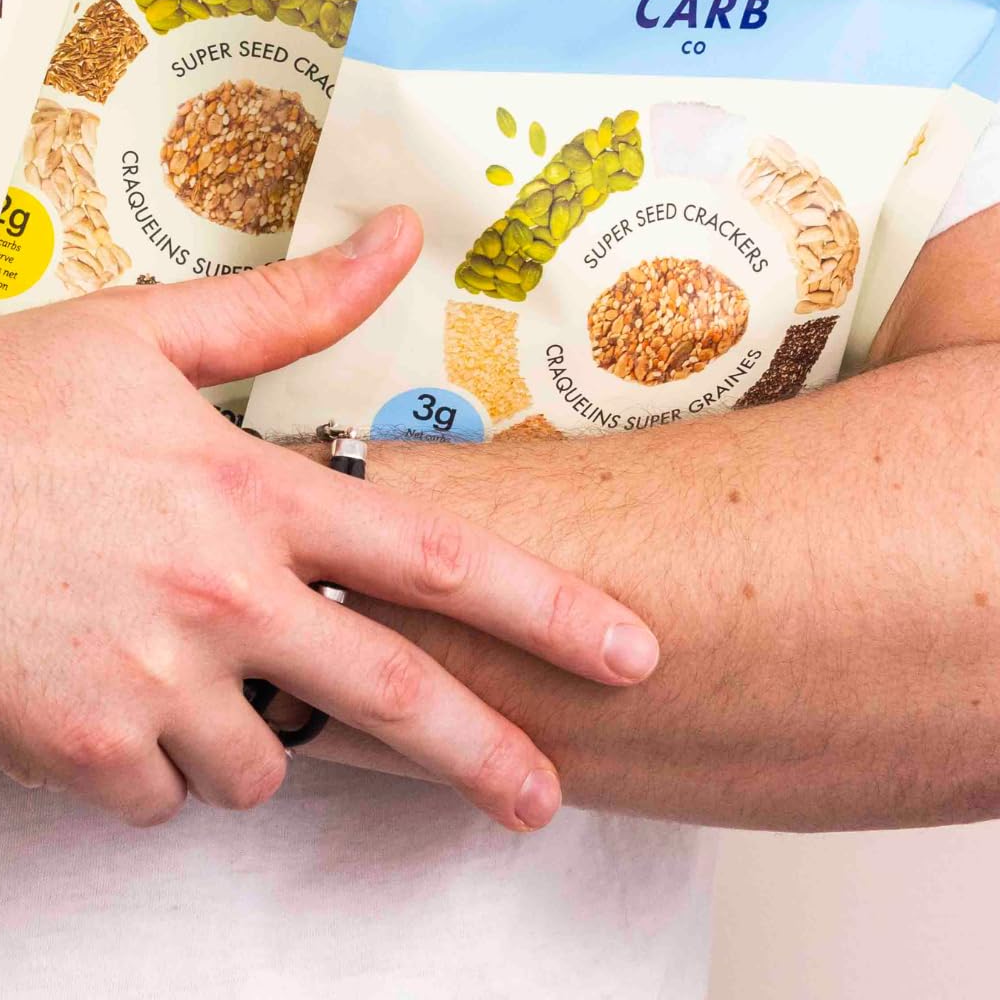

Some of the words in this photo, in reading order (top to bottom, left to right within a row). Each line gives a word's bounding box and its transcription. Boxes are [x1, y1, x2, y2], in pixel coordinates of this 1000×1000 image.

[171, 42, 232, 78] SUPER
[239, 41, 289, 63] SEED
[681, 40, 706, 55] CO
[122, 150, 190, 266] CRAQUELINS
[583, 219, 633, 269] SUPER
[635, 203, 677, 227] SEED
[683, 204, 769, 273] CRACKERS
[3, 270, 18, 280] net
[546, 344, 621, 429] CRAQUELINS
[624, 408, 681, 431] SUPER
[688, 349, 762, 413] GRAINES
[413, 394, 457, 431] 3g
